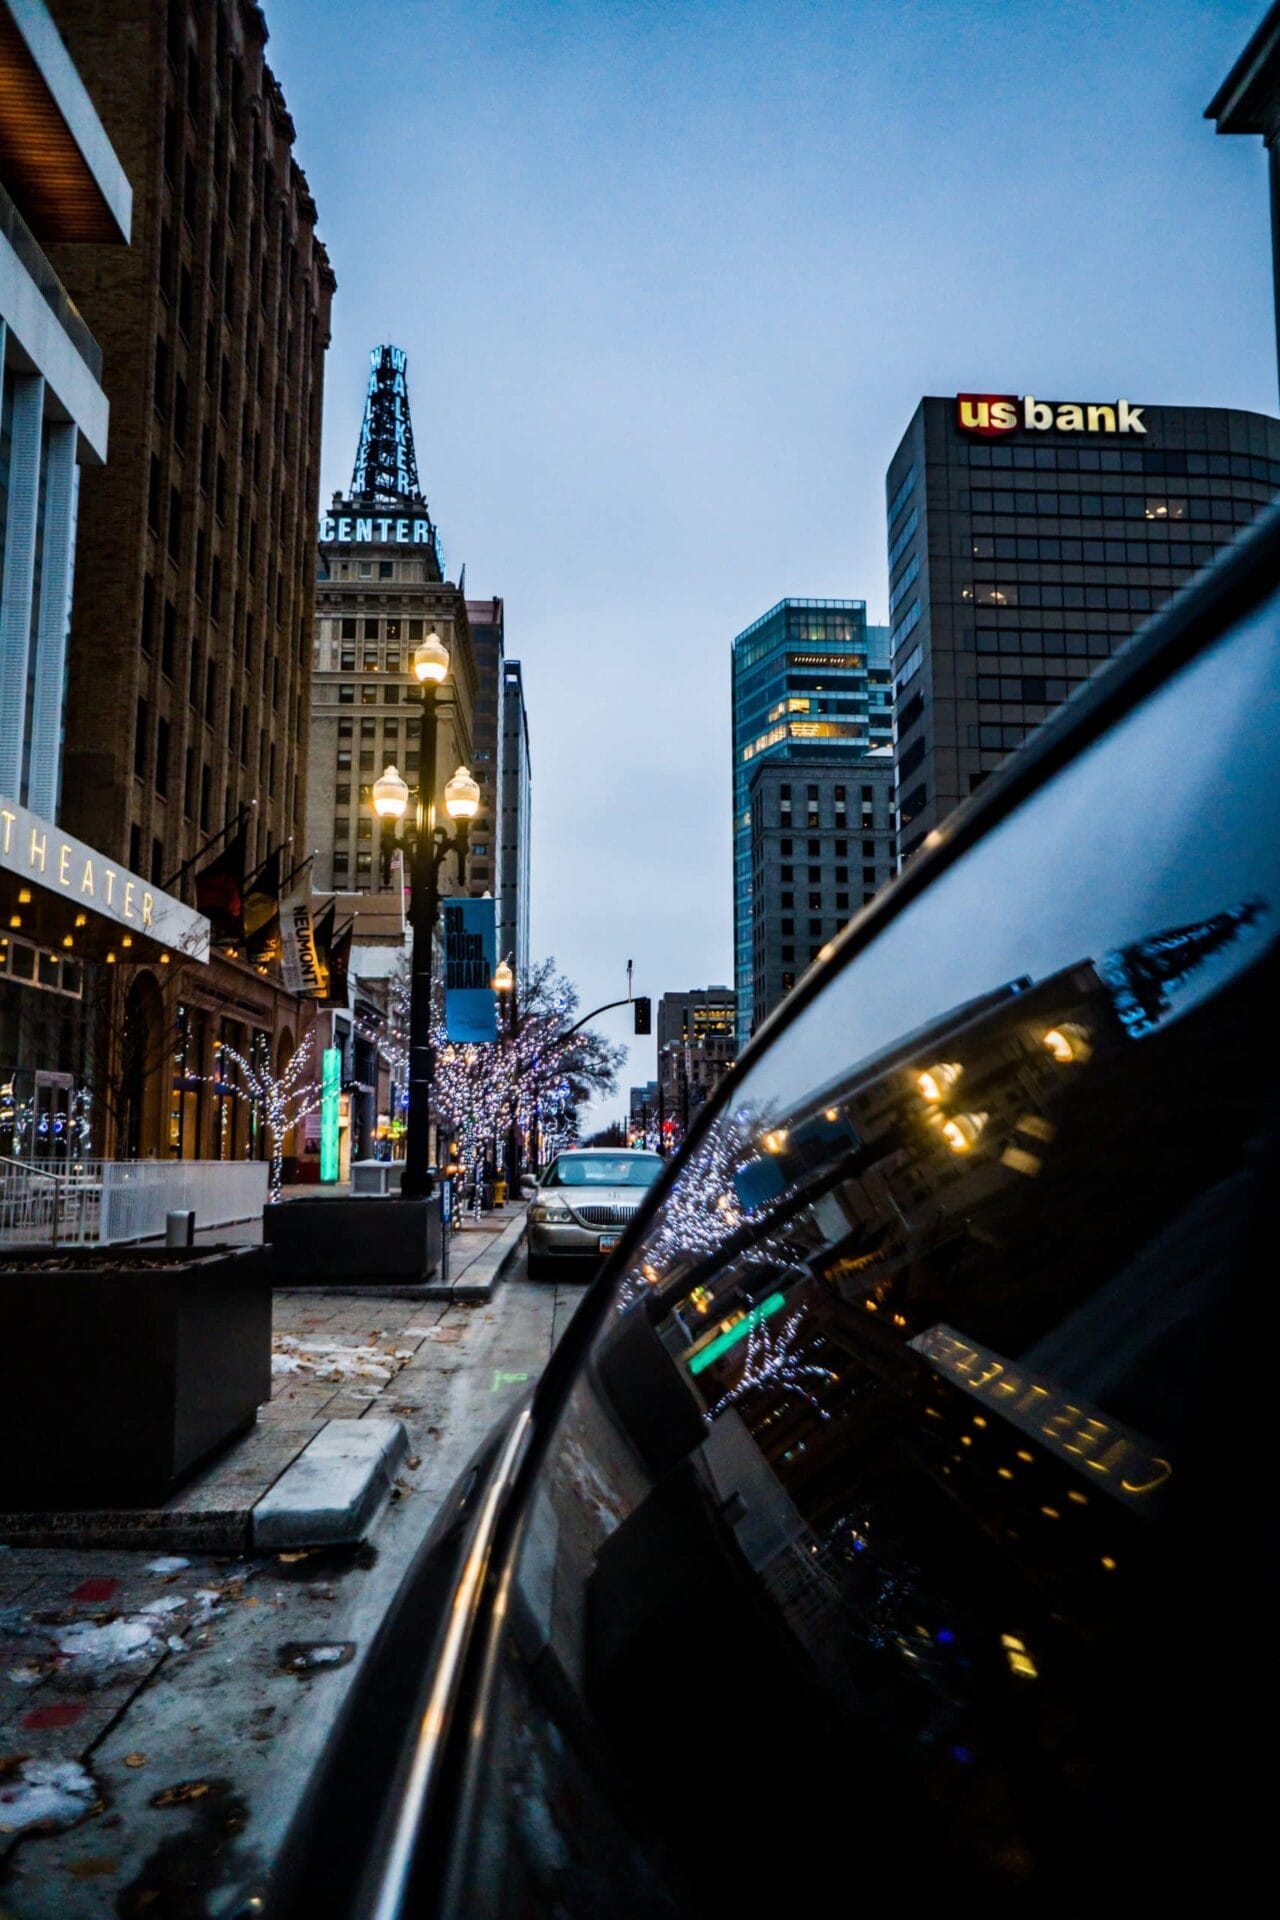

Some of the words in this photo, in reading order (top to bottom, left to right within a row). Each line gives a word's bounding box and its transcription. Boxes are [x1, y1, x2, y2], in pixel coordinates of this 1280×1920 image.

[355, 347, 382, 492] WALKER
[390, 346, 409, 495] WALKER
[1024, 396, 1147, 433] bank
[319, 517, 429, 543] CENTER
[2, 810, 153, 928] THEATER
[293, 905, 318, 986] NEUMONT
